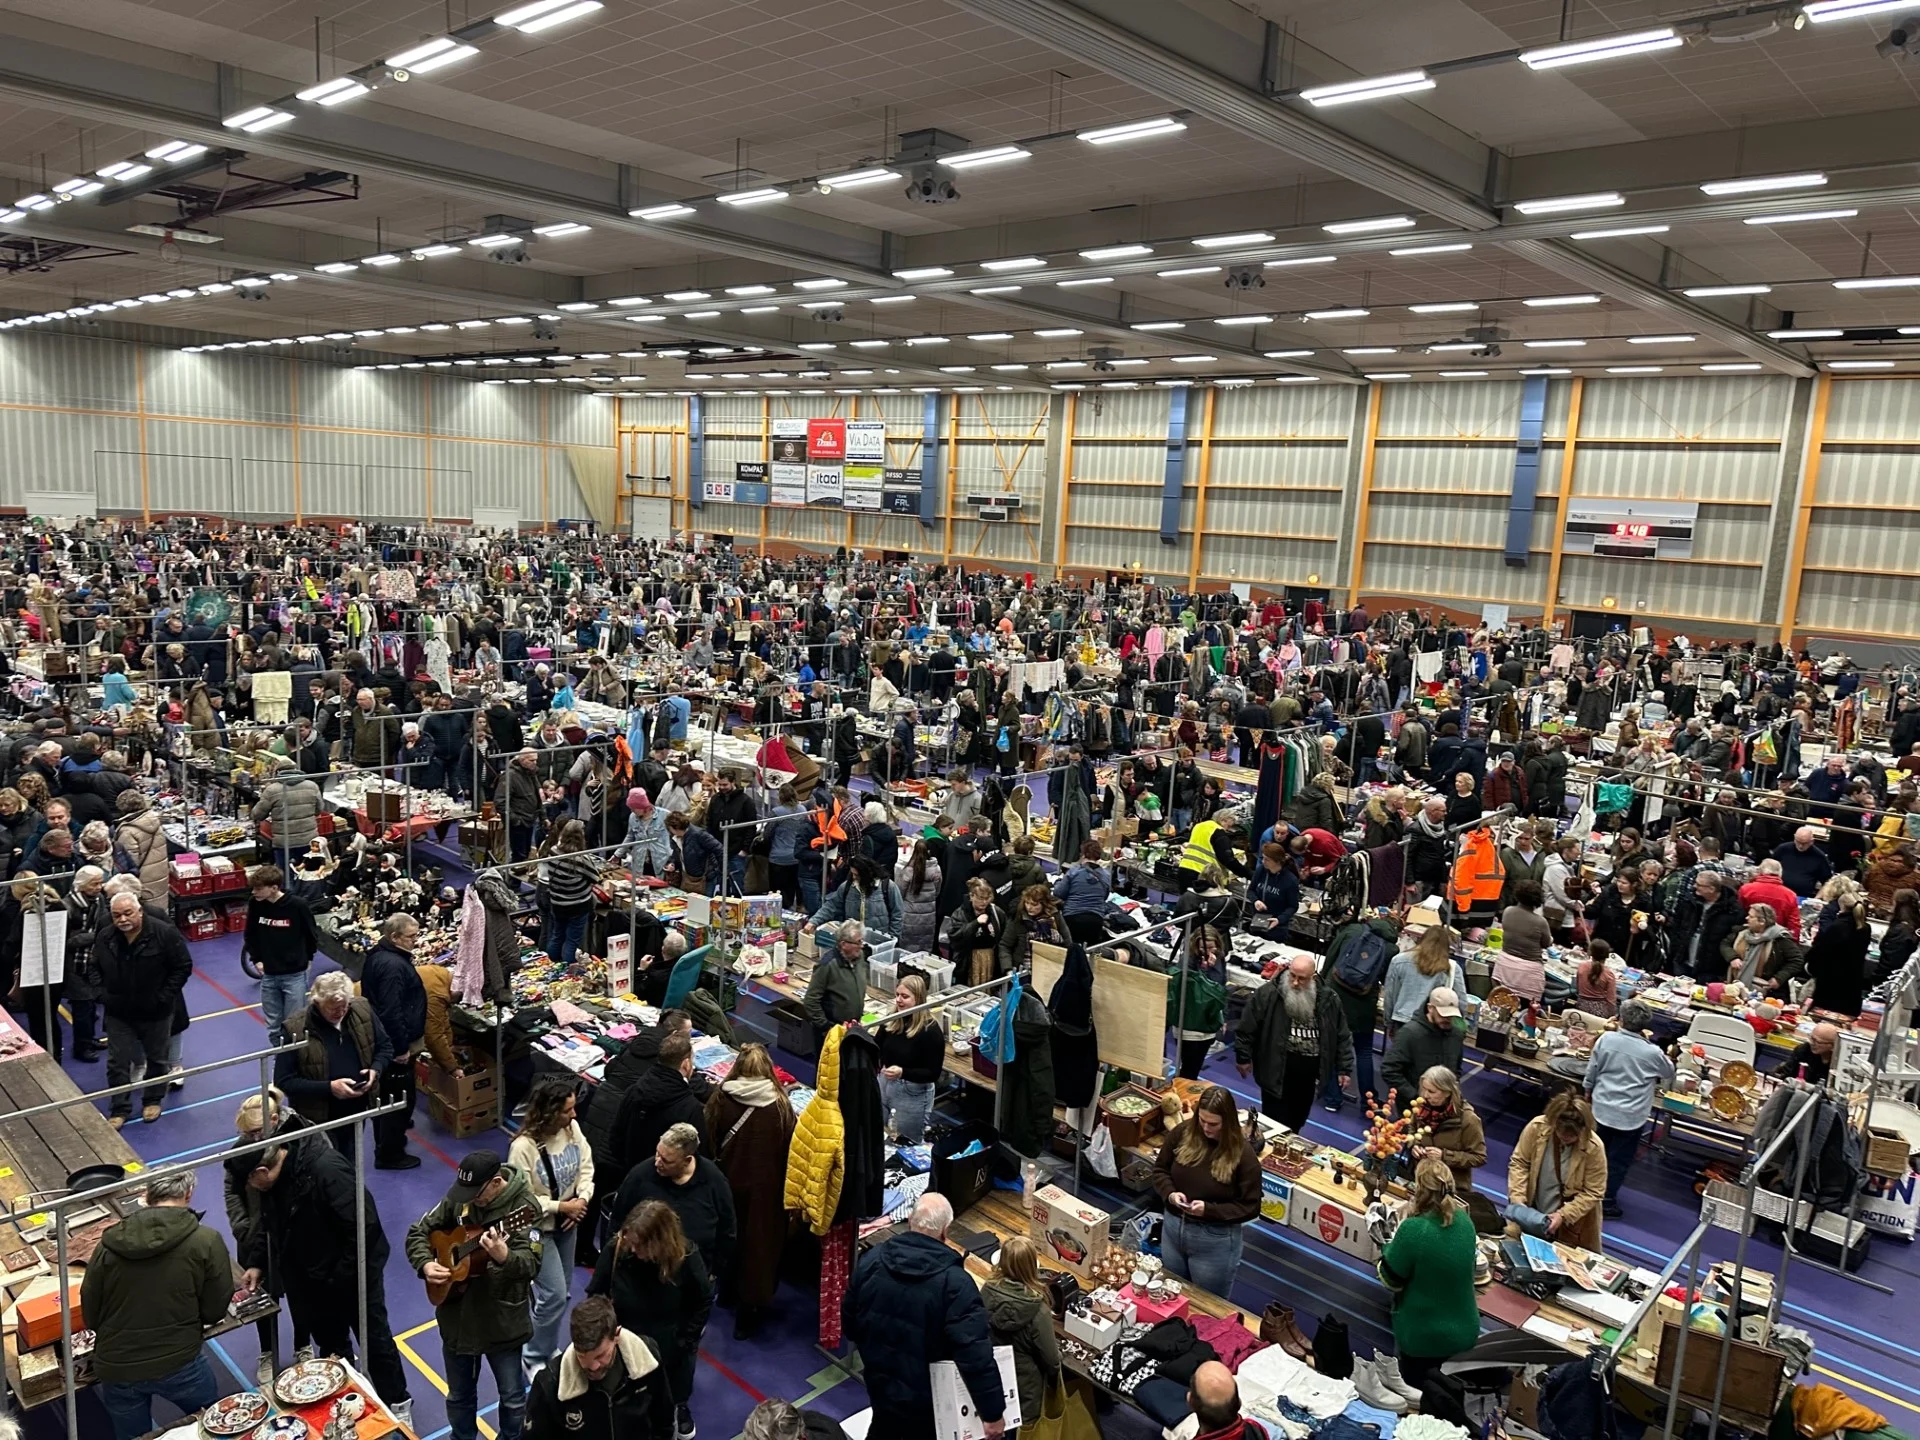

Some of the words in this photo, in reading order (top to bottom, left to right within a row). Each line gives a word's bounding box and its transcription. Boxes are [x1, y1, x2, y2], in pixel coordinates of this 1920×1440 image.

[849, 433, 861, 446] VIA
[863, 433, 881, 447] DATA
[740, 464, 764, 474] KOMPAS
